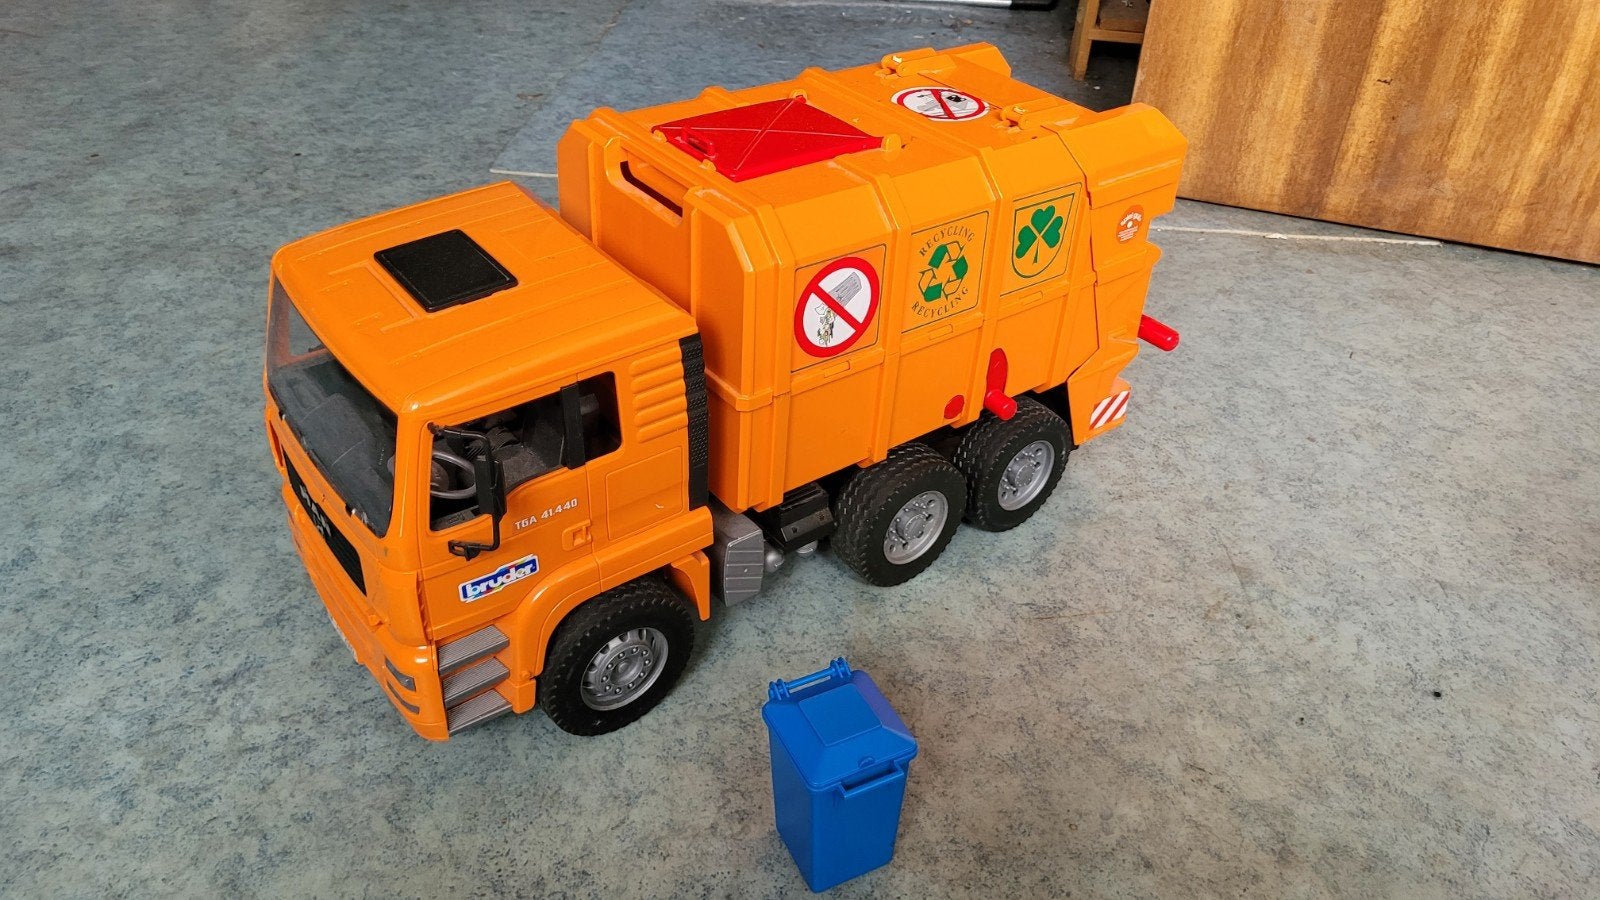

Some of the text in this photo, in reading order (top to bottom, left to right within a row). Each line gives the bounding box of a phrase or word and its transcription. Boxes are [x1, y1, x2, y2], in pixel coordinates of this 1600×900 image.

[919, 225, 975, 257] RECYCLING
[911, 286, 969, 318] RECYCLING
[515, 515, 537, 530] TGA
[466, 563, 533, 598] bruder
